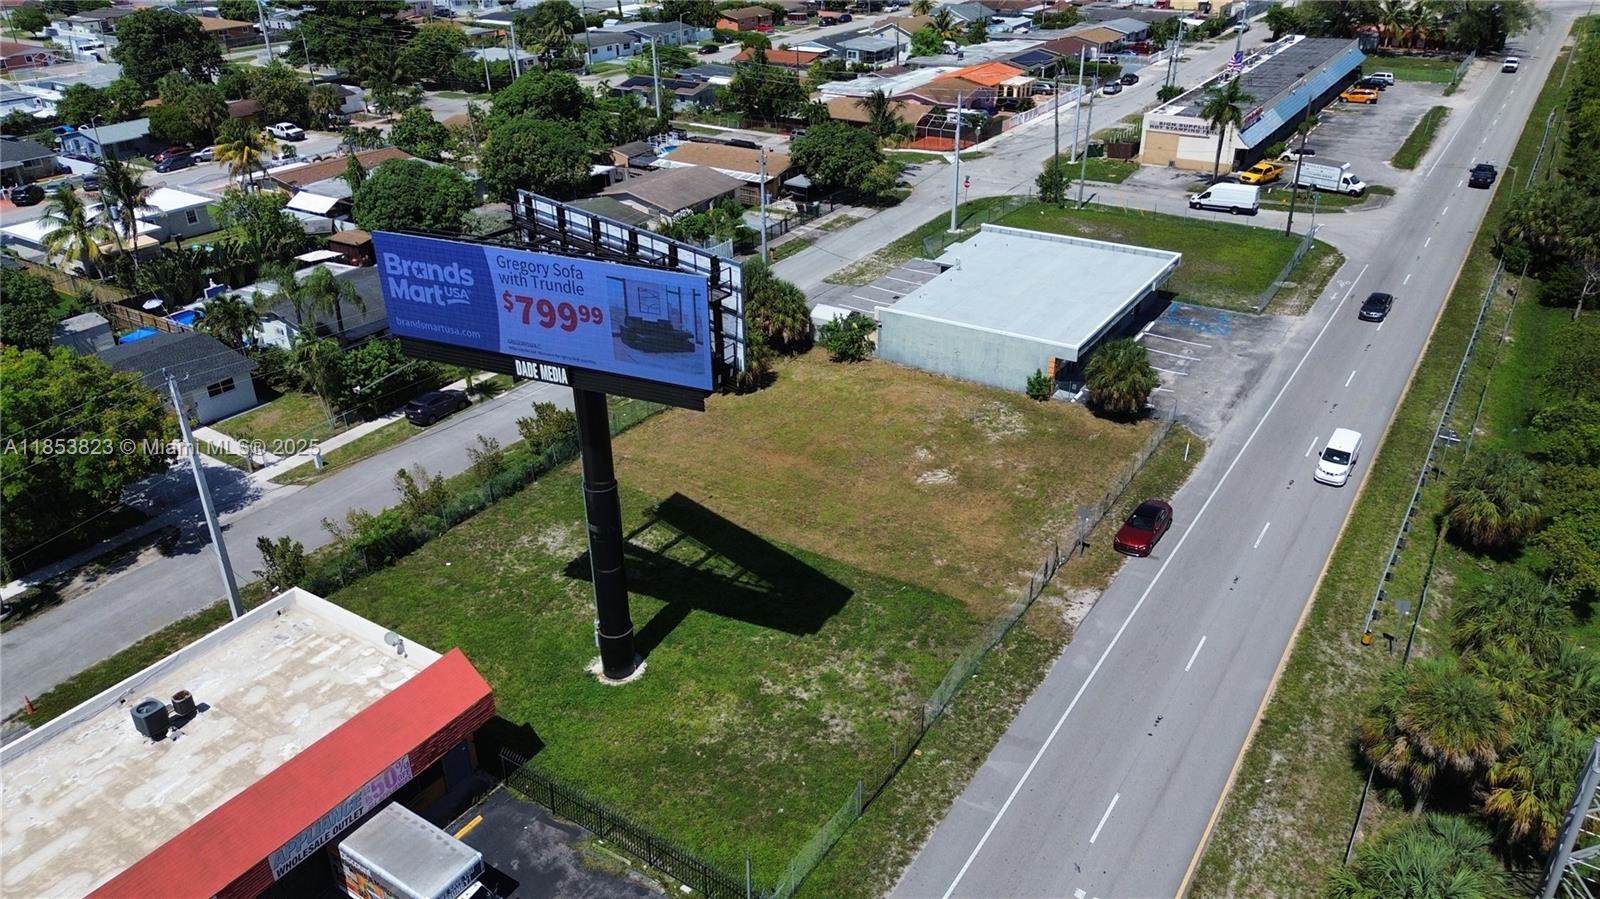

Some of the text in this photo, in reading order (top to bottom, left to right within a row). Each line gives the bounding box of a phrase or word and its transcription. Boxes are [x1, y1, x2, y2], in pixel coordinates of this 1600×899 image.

[1179, 123, 1213, 131] SUPPLIE
[382, 252, 475, 287] Brands
[496, 254, 584, 281] Gregory Sofa
[388, 281, 471, 306] Mart USA
[498, 272, 585, 296] with Trundle
[395, 316, 481, 340] brandsmartusa.com
[515, 359, 569, 385] DADE MEDIA
[371, 757, 410, 800] 50%
[272, 792, 363, 871] APPLIANCE
[276, 831, 331, 878] WHOLESALE
[332, 808, 365, 835] OUTLET
